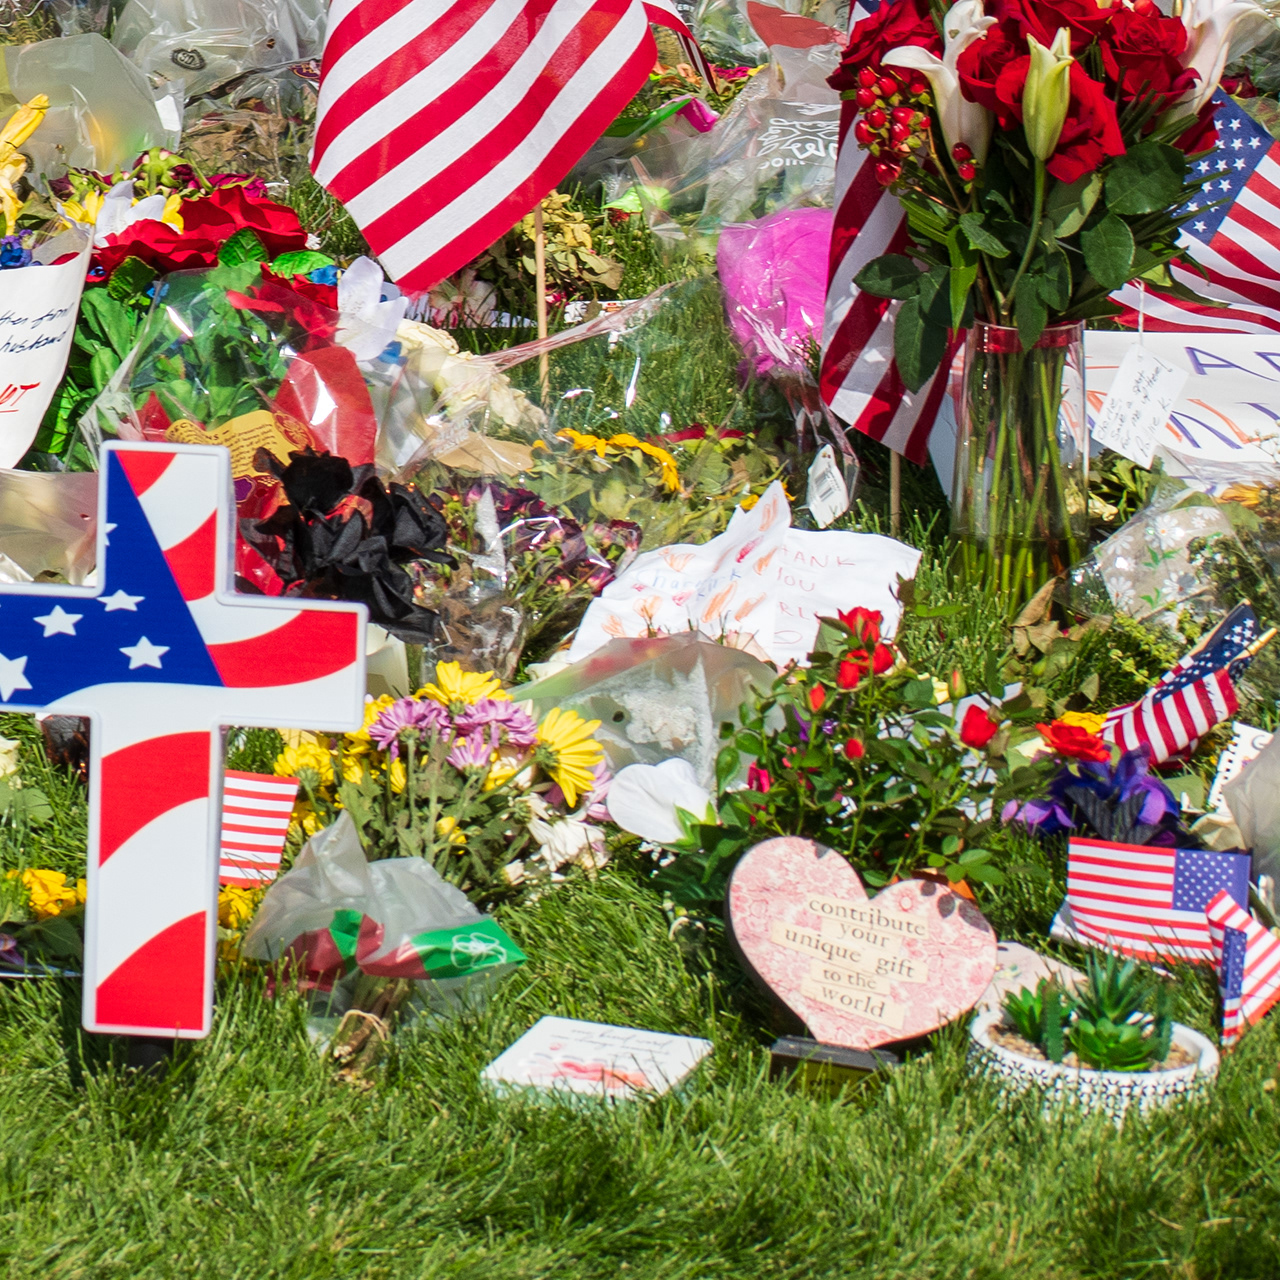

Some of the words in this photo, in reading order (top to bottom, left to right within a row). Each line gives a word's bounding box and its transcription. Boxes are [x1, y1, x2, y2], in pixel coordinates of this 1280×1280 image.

[808, 898, 926, 937] contribute
[839, 922, 891, 949] your
[784, 927, 862, 963] unique
[875, 954, 916, 980] gift
[823, 967, 841, 983] to
[847, 971, 878, 991] the
[822, 986, 886, 1019] world
